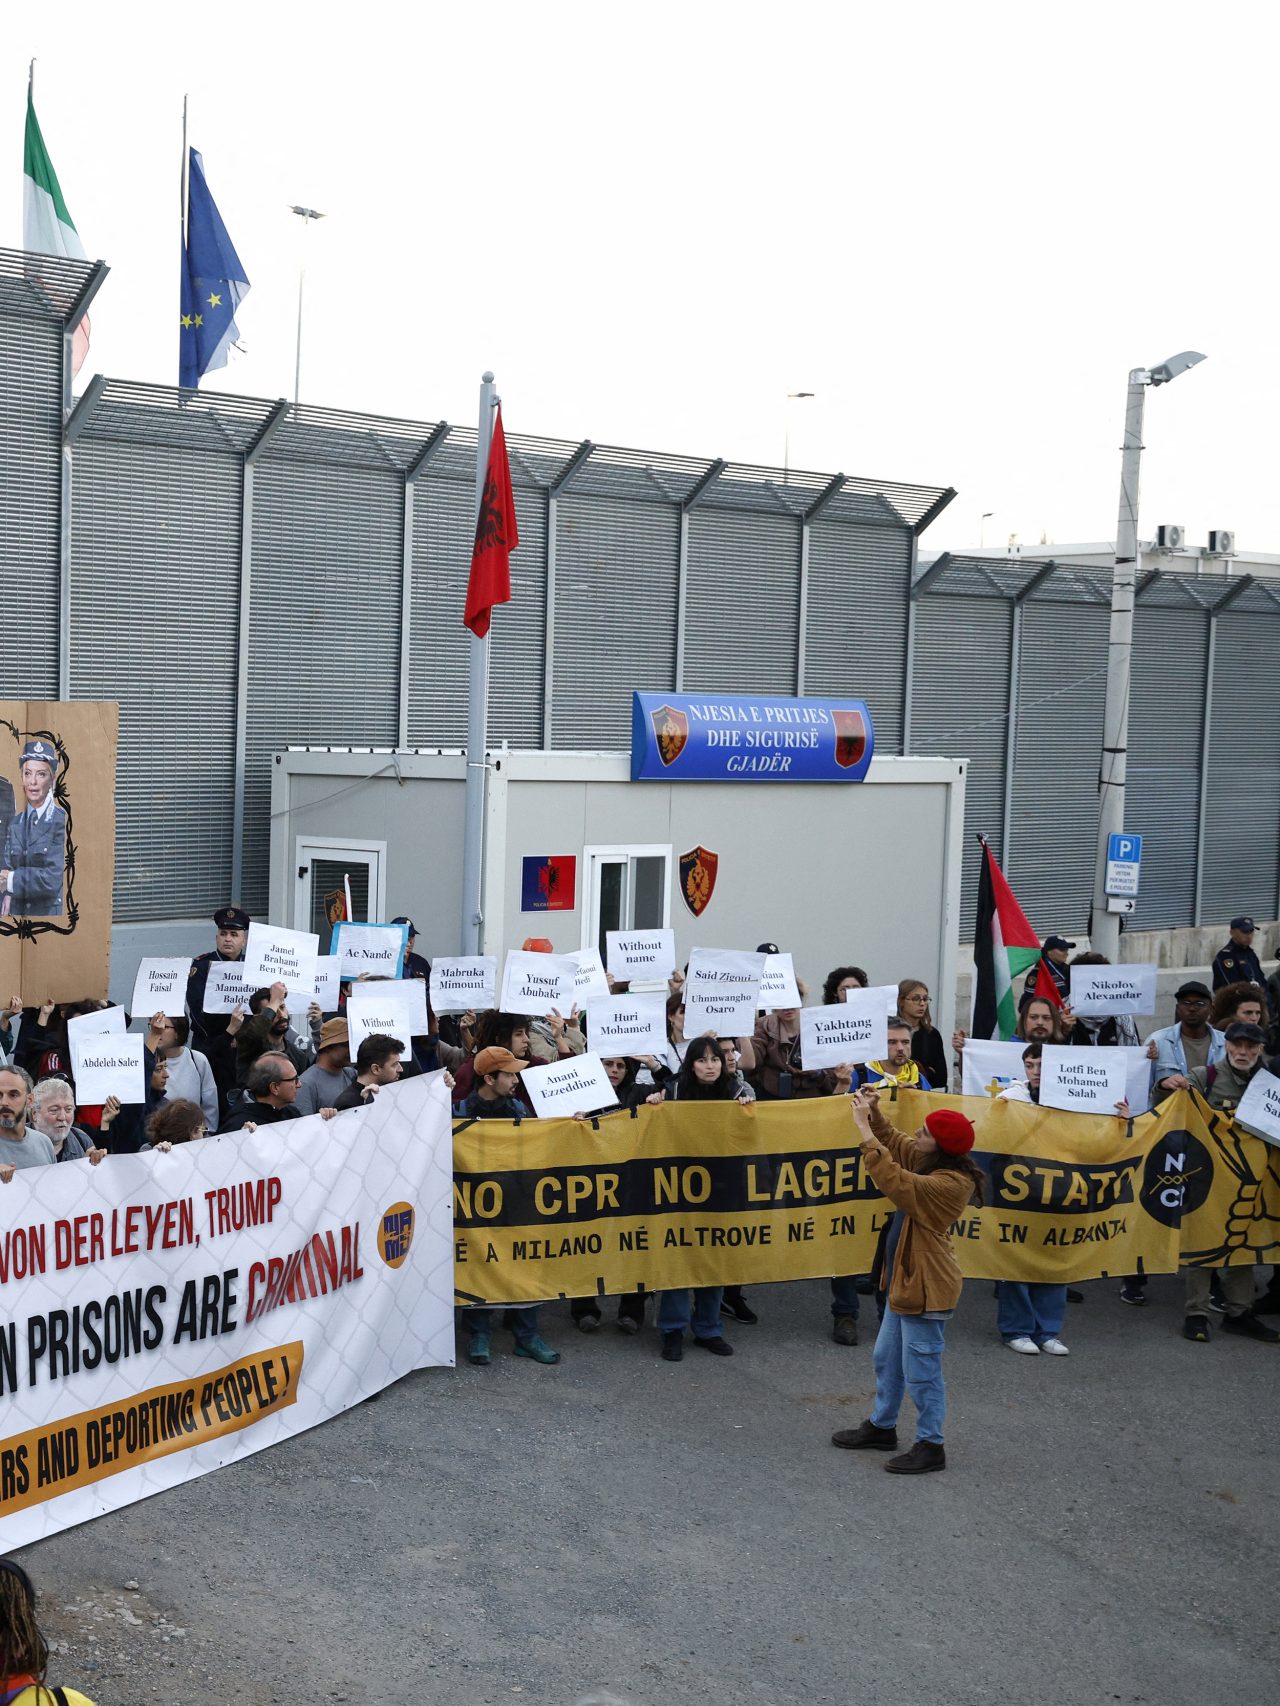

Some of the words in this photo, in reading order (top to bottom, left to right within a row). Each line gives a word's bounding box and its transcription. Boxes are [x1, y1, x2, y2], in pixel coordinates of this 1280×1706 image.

[688, 704, 749, 721] NJESIA
[749, 706, 762, 721] E
[764, 706, 829, 724] PRITJES
[707, 729, 741, 747] DHE
[745, 728, 819, 748] SIGURISË
[726, 752, 792, 772] GJADËR
[1120, 840, 1132, 858] P
[270, 944, 295, 956] Jamel
[619, 941, 662, 951] Without
[264, 954, 299, 967] Brahami
[362, 949, 393, 960] Nande
[626, 954, 656, 964] name
[148, 970, 178, 980] Hossain
[259, 964, 276, 973] Ben
[277, 967, 301, 979] Taahr
[440, 968, 485, 977] Mabruka
[575, 964, 596, 976] rfaoui
[695, 969, 718, 980] Said
[439, 980, 485, 990] Mimouni
[526, 973, 560, 986] Yussuf
[1091, 980, 1136, 990] Nikolov
[149, 983, 172, 992] Faisal
[519, 986, 561, 999] Abubakr
[223, 994, 249, 1004] Balde
[1084, 991, 1143, 1000] Alexandar
[705, 1004, 735, 1014] Osaro
[361, 1017, 395, 1028] Without
[614, 1012, 638, 1022] Huri
[600, 1023, 651, 1036] Mohamed
[814, 1019, 872, 1032] Vakhtang
[816, 1031, 872, 1045] Enukidze
[118, 1058, 139, 1067] Saler
[1060, 1064, 1084, 1074] Lotfi
[1087, 1066, 1106, 1076] Ben
[546, 1069, 579, 1086] Anani
[1057, 1076, 1108, 1088] Mohamed
[540, 1077, 597, 1099] Ezzeddine
[1068, 1088, 1097, 1099] Salah
[1164, 1152, 1186, 1172] N
[453, 1181, 504, 1219] NO
[534, 1173, 621, 1216] CPR
[653, 1165, 712, 1206] NO
[54, 1211, 105, 1271] DER
[111, 1197, 201, 1257] LEYEN,
[204, 1176, 282, 1239] TRUMP
[485, 1242, 499, 1263] A
[512, 1233, 603, 1261] MILANO
[619, 1226, 649, 1251] NÉ
[664, 1224, 772, 1248] ALTROVE
[788, 1216, 815, 1243] NÉ
[829, 1215, 856, 1237] IN
[998, 1222, 1028, 1244] IN
[27, 1285, 167, 1387] PRISONS
[173, 1268, 239, 1345] ARE
[37, 1427, 80, 1487] AND
[86, 1388, 199, 1469] DEPORTING
